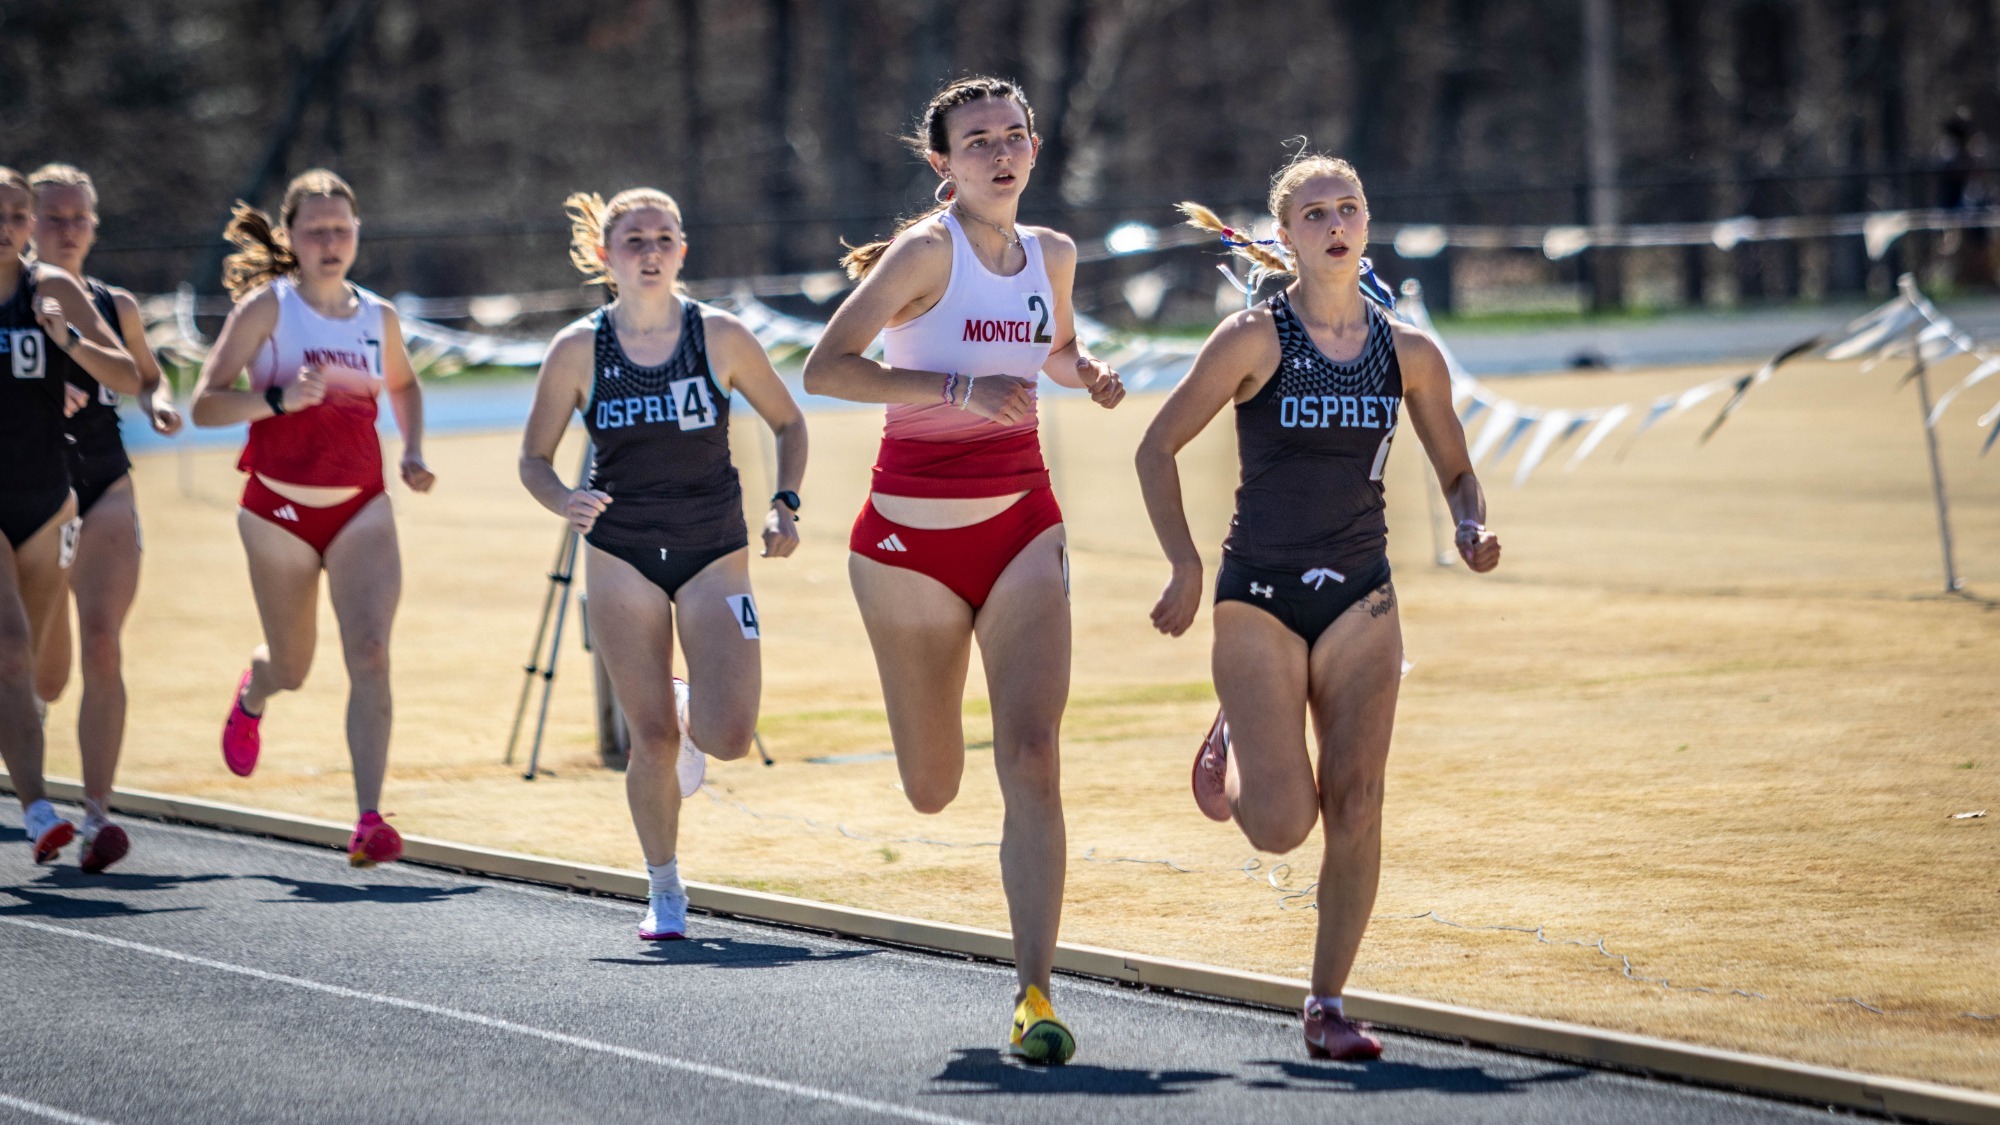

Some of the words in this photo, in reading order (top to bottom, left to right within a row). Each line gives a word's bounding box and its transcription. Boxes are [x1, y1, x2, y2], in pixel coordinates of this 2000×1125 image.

[1027, 295, 1052, 343] 2
[20, 334, 38, 373] 9
[364, 339, 381, 374] 7
[596, 391, 718, 430] OSPRE
[683, 382, 707, 423] 4
[742, 596, 759, 636] 4
